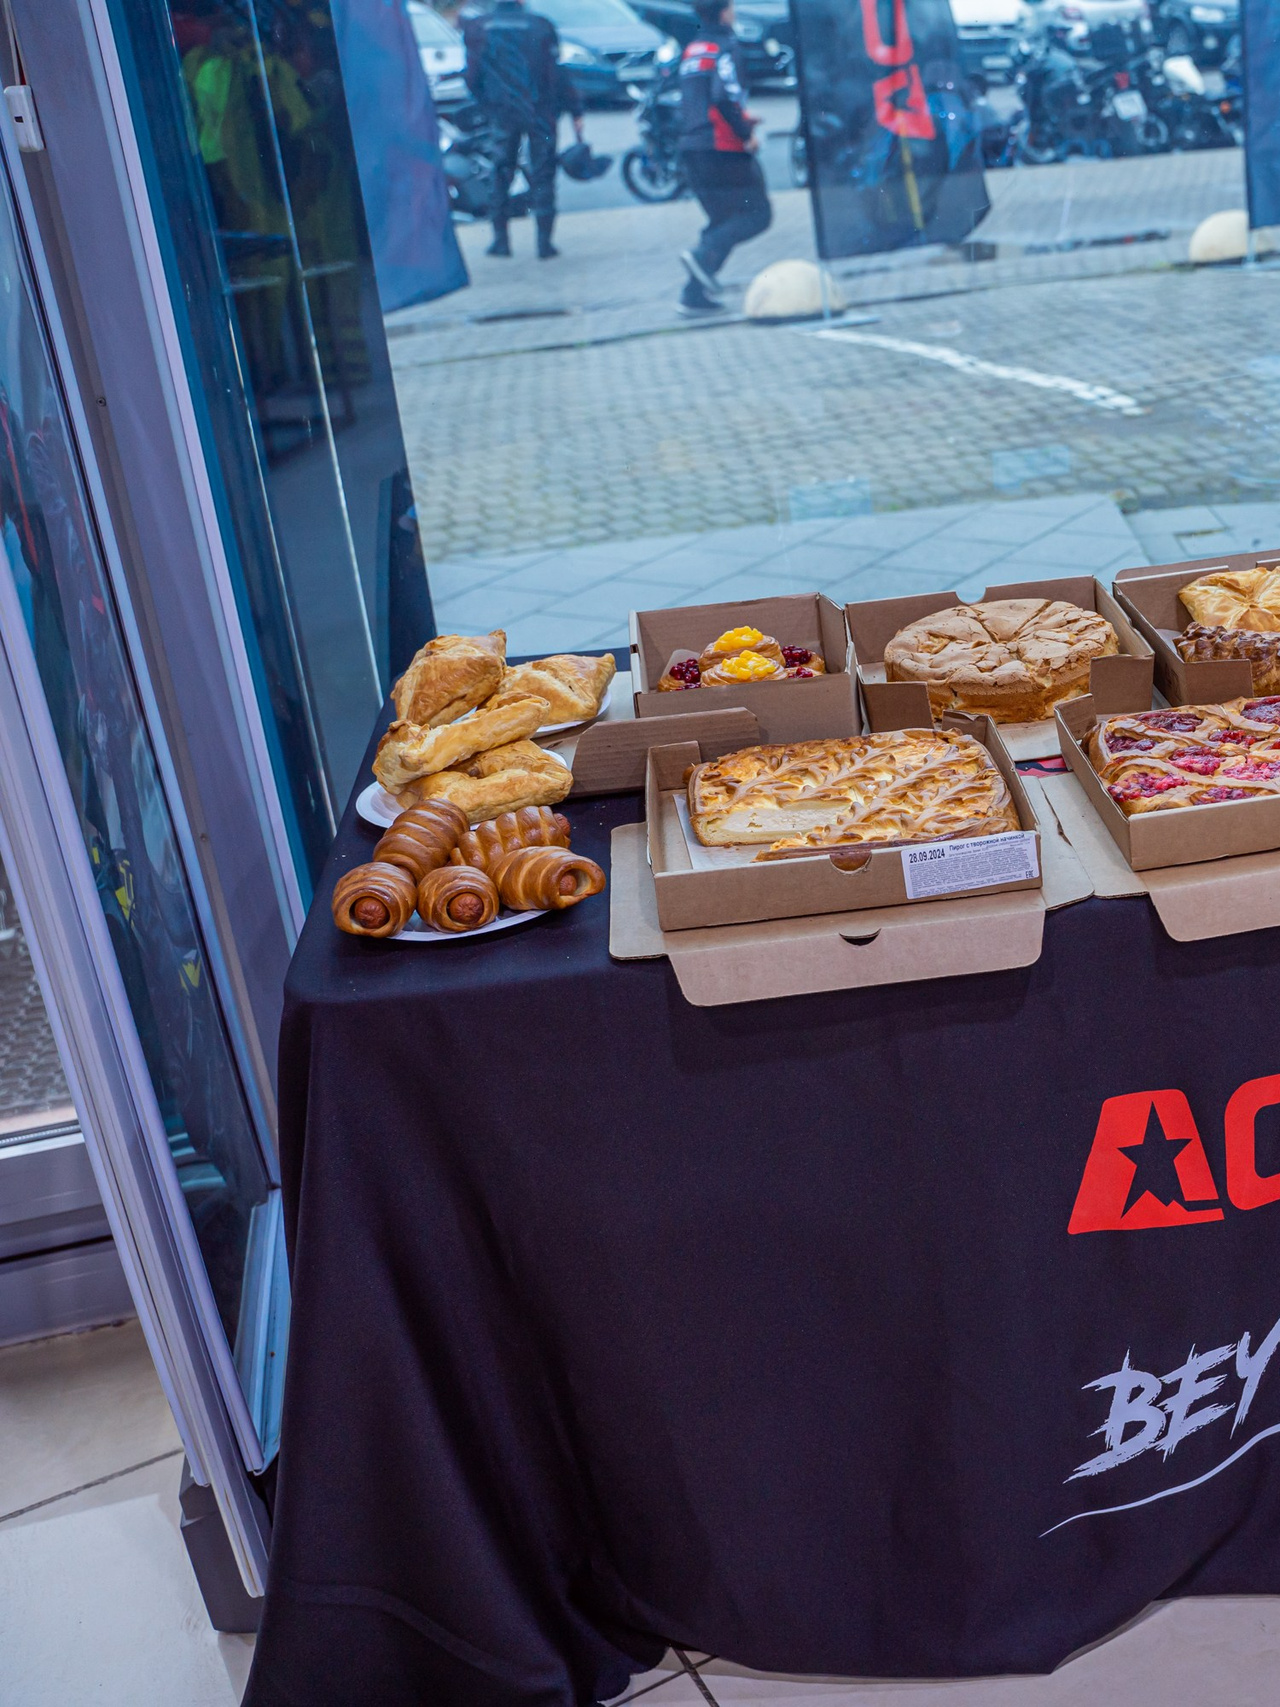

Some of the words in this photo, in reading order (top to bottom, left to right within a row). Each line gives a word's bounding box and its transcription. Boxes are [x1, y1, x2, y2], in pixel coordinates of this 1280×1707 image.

[949, 844, 965, 852] Пирог
[970, 837, 999, 848] творожной
[1001, 833, 1025, 843] начинкой
[908, 848, 946, 864] 28.09.2024
